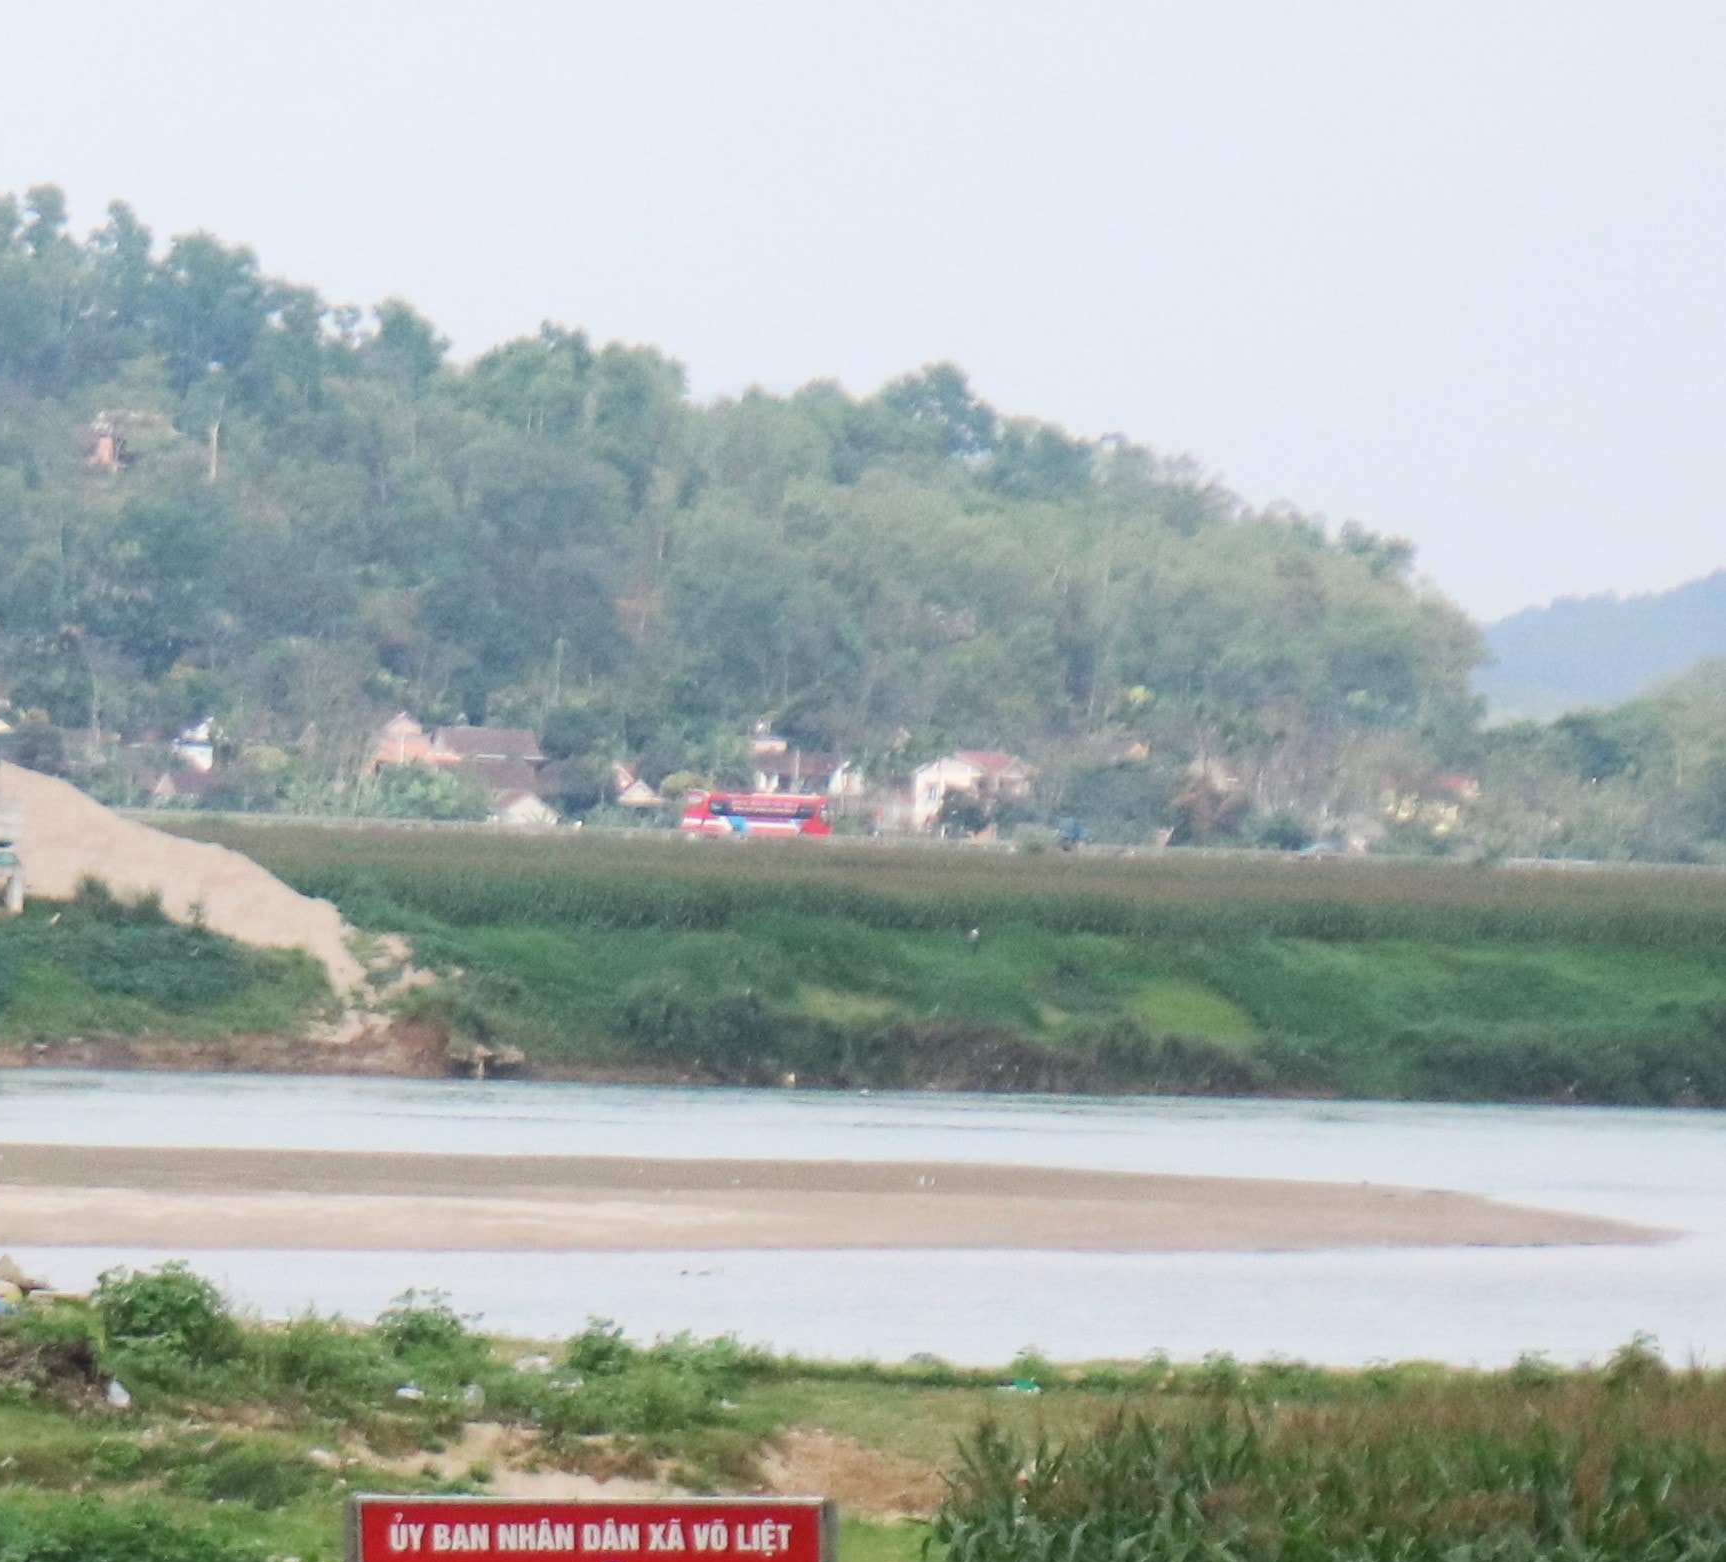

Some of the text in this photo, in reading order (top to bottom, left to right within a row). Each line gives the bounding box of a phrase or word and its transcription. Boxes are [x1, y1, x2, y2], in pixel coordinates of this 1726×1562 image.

[388, 1512, 792, 1558] ỦY BAN NHÂN DÂN XÃ VÕ LIỆT
